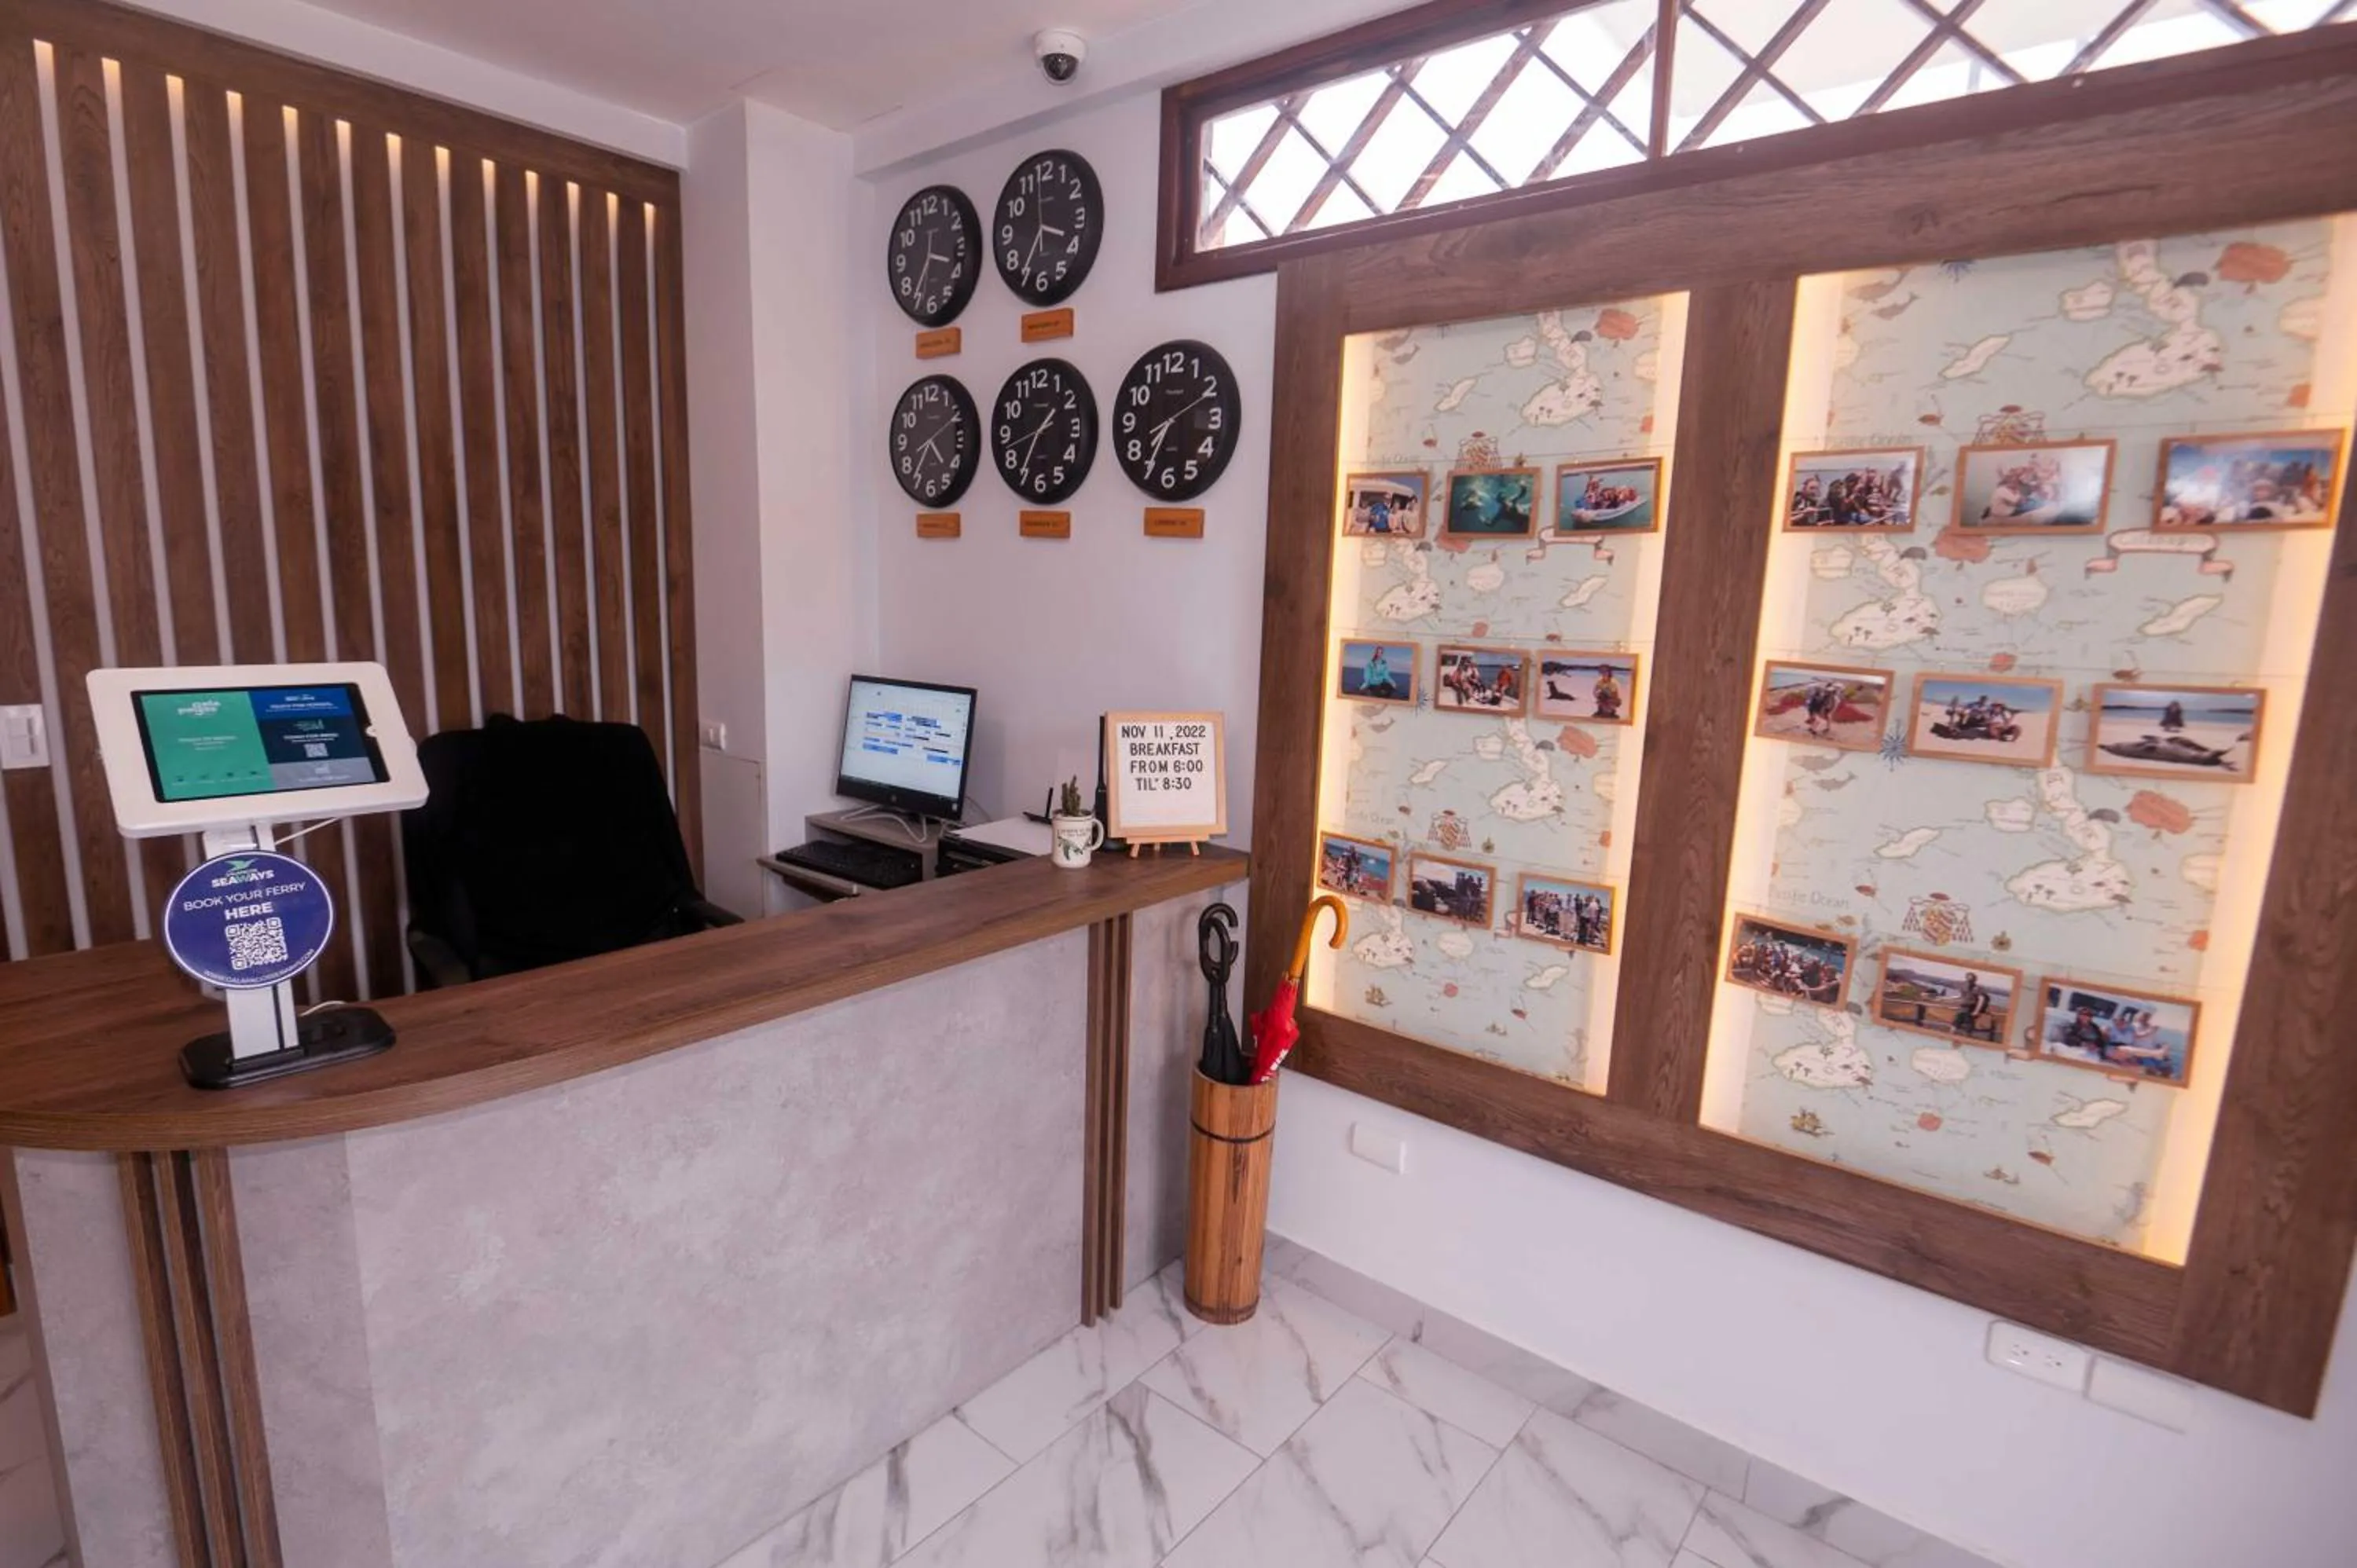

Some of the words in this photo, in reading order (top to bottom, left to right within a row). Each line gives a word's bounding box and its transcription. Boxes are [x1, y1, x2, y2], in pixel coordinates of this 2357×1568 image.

[1035, 160, 1054, 182] 12
[1058, 164, 1066, 183] 1
[1020, 174, 1034, 195] 11
[1069, 178, 1082, 200] 2
[922, 195, 938, 216] 12
[942, 198, 948, 216] 1
[1006, 197, 1025, 218] 10
[909, 208, 922, 227] 11
[951, 211, 962, 231] 2
[1075, 207, 1085, 229] 3
[900, 229, 915, 248] 10
[1002, 225, 1014, 245] 9
[1066, 236, 1079, 255] 4
[896, 254, 906, 273] 9
[1006, 249, 1018, 270] 8
[951, 262, 961, 278] 4
[1055, 261, 1067, 280] 5
[901, 277, 911, 295] 8
[1036, 271, 1048, 291] 6
[914, 292, 922, 310] 7
[927, 295, 937, 314] 6
[1163, 352, 1185, 374] 12
[1191, 358, 1200, 379] 1
[1030, 368, 1048, 389] 12
[1145, 362, 1162, 384] 11
[1015, 380, 1029, 398] 11
[1054, 374, 1061, 392] 1
[1202, 376, 1217, 397] 2
[911, 394, 923, 410] 11
[924, 384, 939, 402] 12
[943, 390, 949, 407] 1
[1064, 390, 1076, 410] 2
[1130, 385, 1150, 406] 10
[1005, 400, 1021, 419] 10
[1208, 407, 1222, 429] 3
[902, 412, 916, 428] 10
[1070, 418, 1080, 438] 3
[1122, 412, 1136, 433] 9
[898, 434, 907, 451] 9
[1000, 425, 1011, 444] 9
[1064, 443, 1076, 463] 4
[1127, 439, 1142, 461] 8
[1197, 436, 1214, 457] 4
[902, 456, 912, 474] 8
[949, 454, 960, 469] 4
[1005, 449, 1017, 469] 8
[1053, 466, 1065, 485] 5
[1144, 460, 1156, 480] 7
[1160, 467, 1175, 489] 6
[1184, 460, 1198, 480] 5
[913, 473, 922, 489] 7
[926, 479, 936, 497] 6
[941, 473, 951, 489] 5
[1035, 473, 1046, 493] 6
[1121, 725, 1146, 738] NOV
[1130, 742, 1200, 756] BREAKFAST
[1131, 760, 1168, 773] FROM
[1173, 760, 1203, 773] 6:00
[1163, 777, 1192, 789] 8:30
[211, 870, 275, 888] SEAWAYS
[183, 896, 223, 911] BOOK
[225, 889, 263, 903] YOUR
[266, 881, 306, 896] FERRY
[225, 902, 274, 921] HERE
